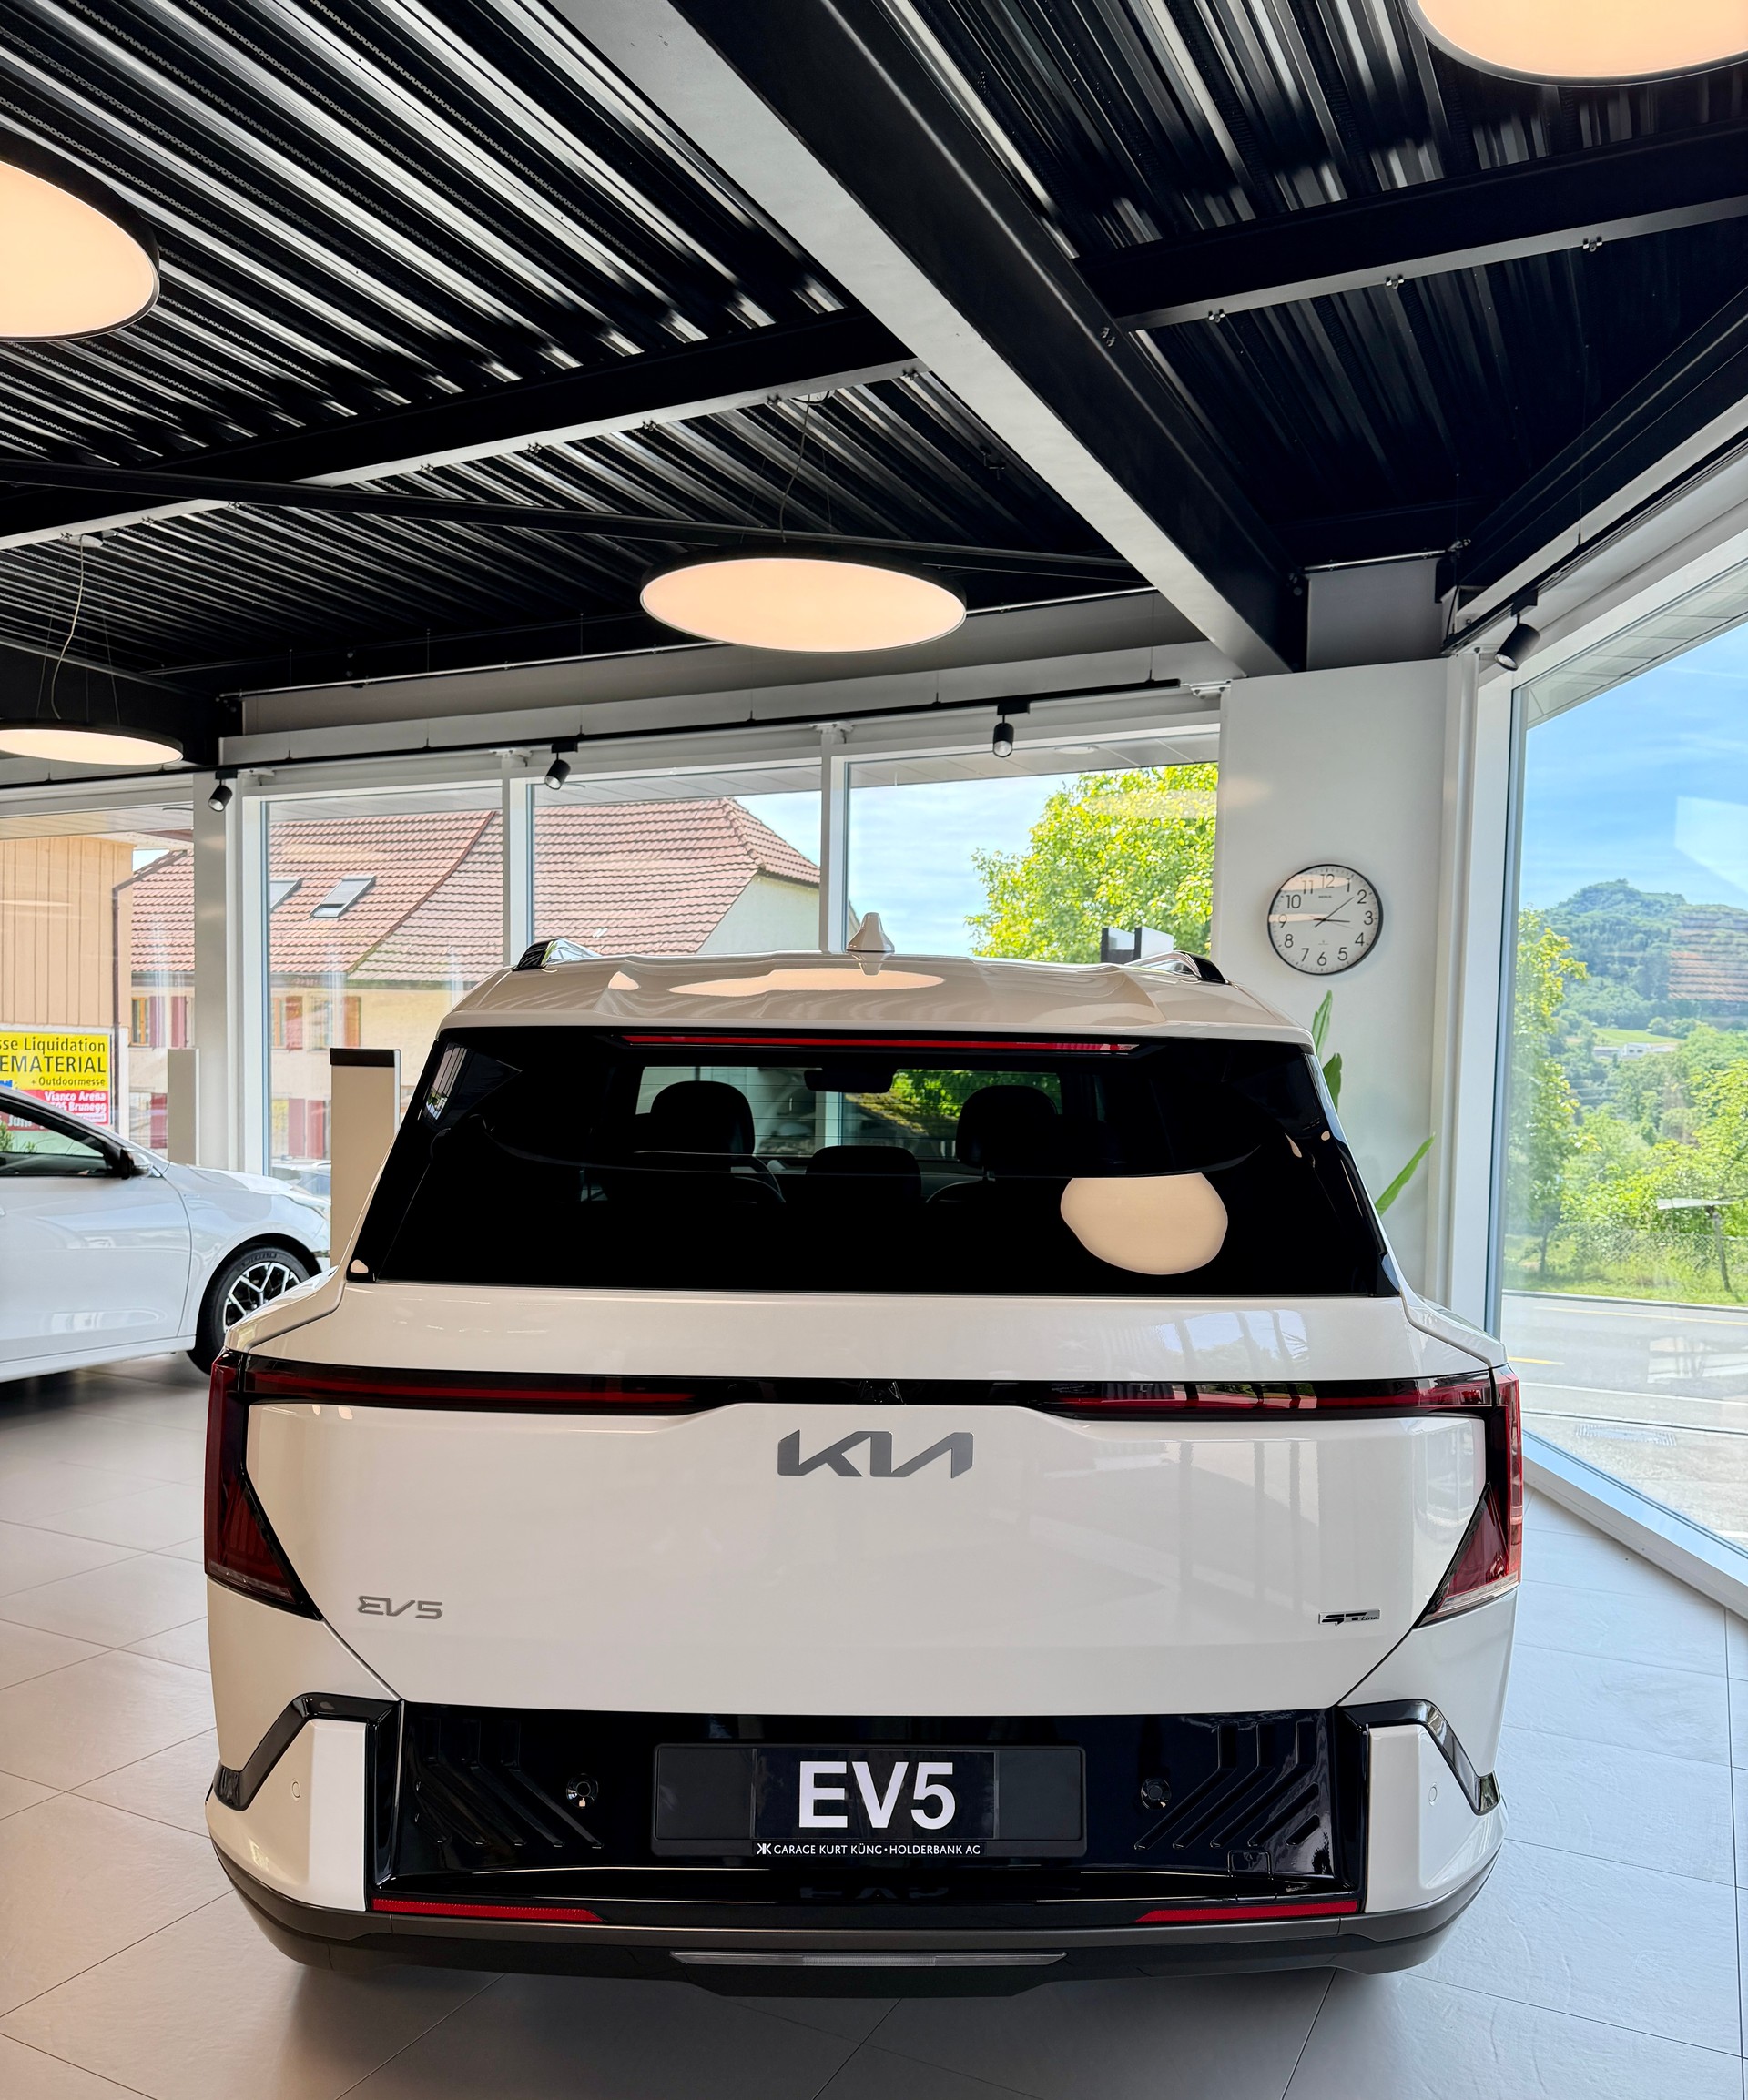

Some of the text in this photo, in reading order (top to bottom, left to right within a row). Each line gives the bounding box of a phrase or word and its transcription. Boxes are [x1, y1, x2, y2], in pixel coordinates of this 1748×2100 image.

[1302, 880, 1314, 894] 11
[1321, 874, 1335, 888] 12
[1346, 878, 1351, 892] 1
[1286, 894, 1301, 908] 10
[1357, 889, 1367, 904] 2
[1278, 913, 1287, 928] 9
[1364, 910, 1374, 926] 3
[1284, 933, 1294, 948] 8
[1354, 932, 1365, 947] 4
[1301, 948, 1309, 962] 7
[1316, 951, 1327, 966] 6
[1337, 947, 1347, 961] 5
[0, 1036, 106, 1055] se Liquidation
[0, 1055, 107, 1073] EMATERIAL
[38, 1076, 106, 1087] Outdoormesse
[45, 1091, 107, 1101] Vianco Arena
[68, 1101, 107, 1114] Brunegg
[777, 1429, 974, 1479] KIA
[357, 1595, 443, 1619] EV5
[798, 1760, 956, 1830] EV5
[773, 1844, 816, 1855] GARAGE
[819, 1844, 848, 1855] KURT
[965, 1844, 981, 1855] AG
